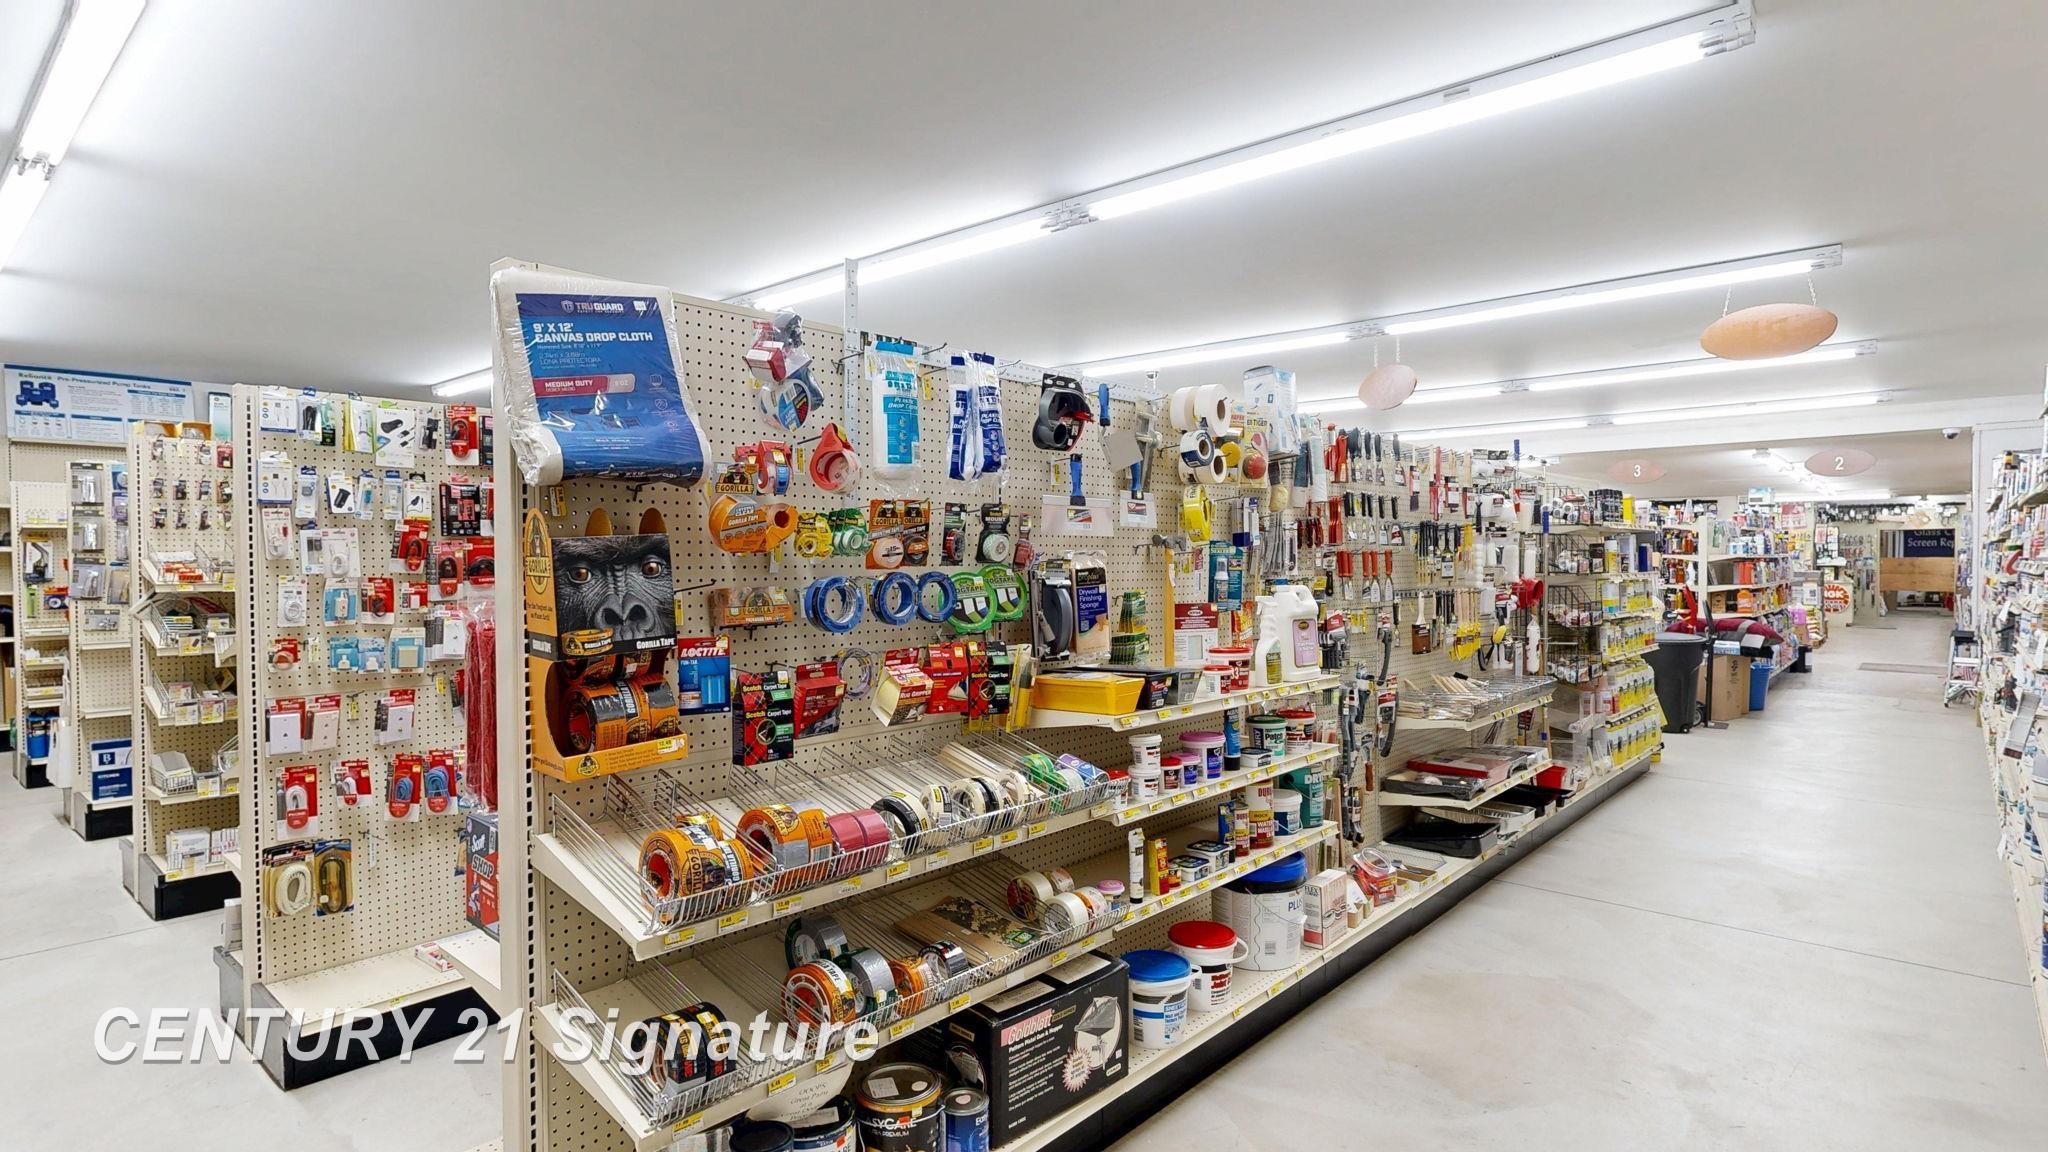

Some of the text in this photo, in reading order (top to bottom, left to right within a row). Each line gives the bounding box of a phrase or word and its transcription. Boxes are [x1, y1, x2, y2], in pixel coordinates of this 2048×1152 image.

[533, 323, 574, 333] 9' X 12'
[535, 332, 653, 343] CANVAS DROP CLOTH
[545, 381, 573, 389] MEDIUM
[575, 380, 593, 388] DUTY
[1834, 456, 1845, 471] 2
[1633, 465, 1641, 477] 3
[720, 485, 749, 493] GORILLA
[875, 518, 899, 526] GORILLA
[1908, 538, 1937, 547] Screen
[528, 560, 547, 573] GORILLA
[987, 576, 1015, 585] OGTAPE
[956, 586, 984, 595] OGTAPE
[1079, 588, 1099, 596] Drywall
[746, 606, 772, 614] GORILLA
[1080, 602, 1099, 610] Sponge
[636, 637, 675, 650] GORILLA TAPE
[681, 647, 726, 658] LOCTITE
[745, 710, 766, 718] Scotch
[472, 855, 493, 877] SHOP
[829, 967, 841, 981] TAPE
[1008, 1013, 1053, 1046] Goldblatt
[1008, 1042, 1025, 1053] Pattern
[1025, 1035, 1036, 1046] Pistol
[1036, 1032, 1045, 1040] Gun
[866, 1117, 917, 1130] ASYCARE
